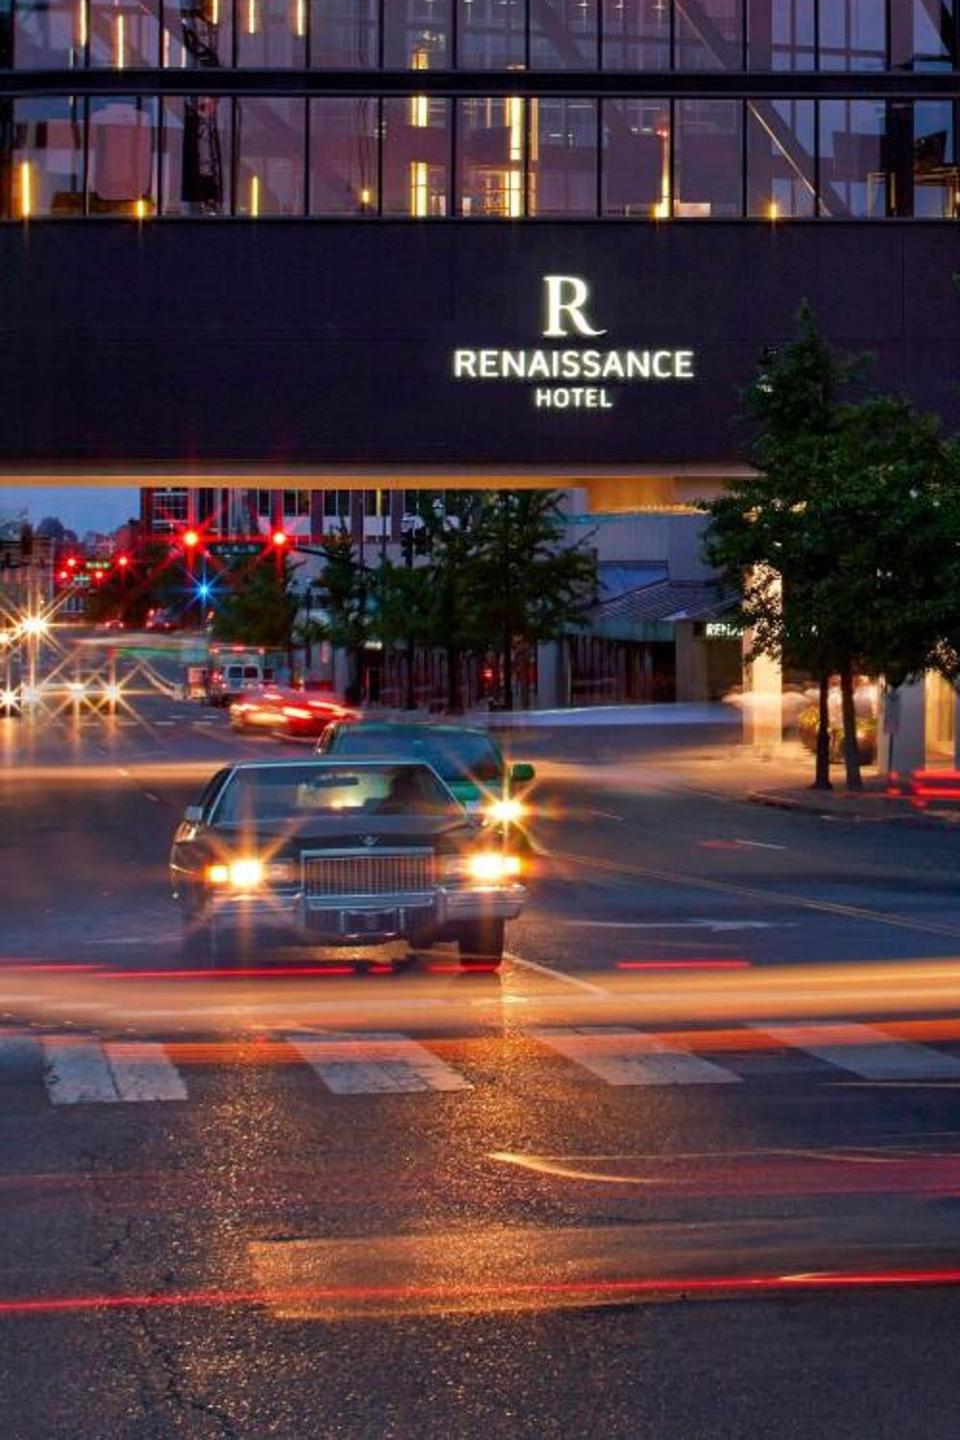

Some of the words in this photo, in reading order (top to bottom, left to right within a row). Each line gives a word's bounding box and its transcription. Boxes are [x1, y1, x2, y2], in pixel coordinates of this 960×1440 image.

[542, 275, 607, 337] R
[454, 350, 695, 378] RENAISSANCE
[536, 388, 613, 408] HOTEL
